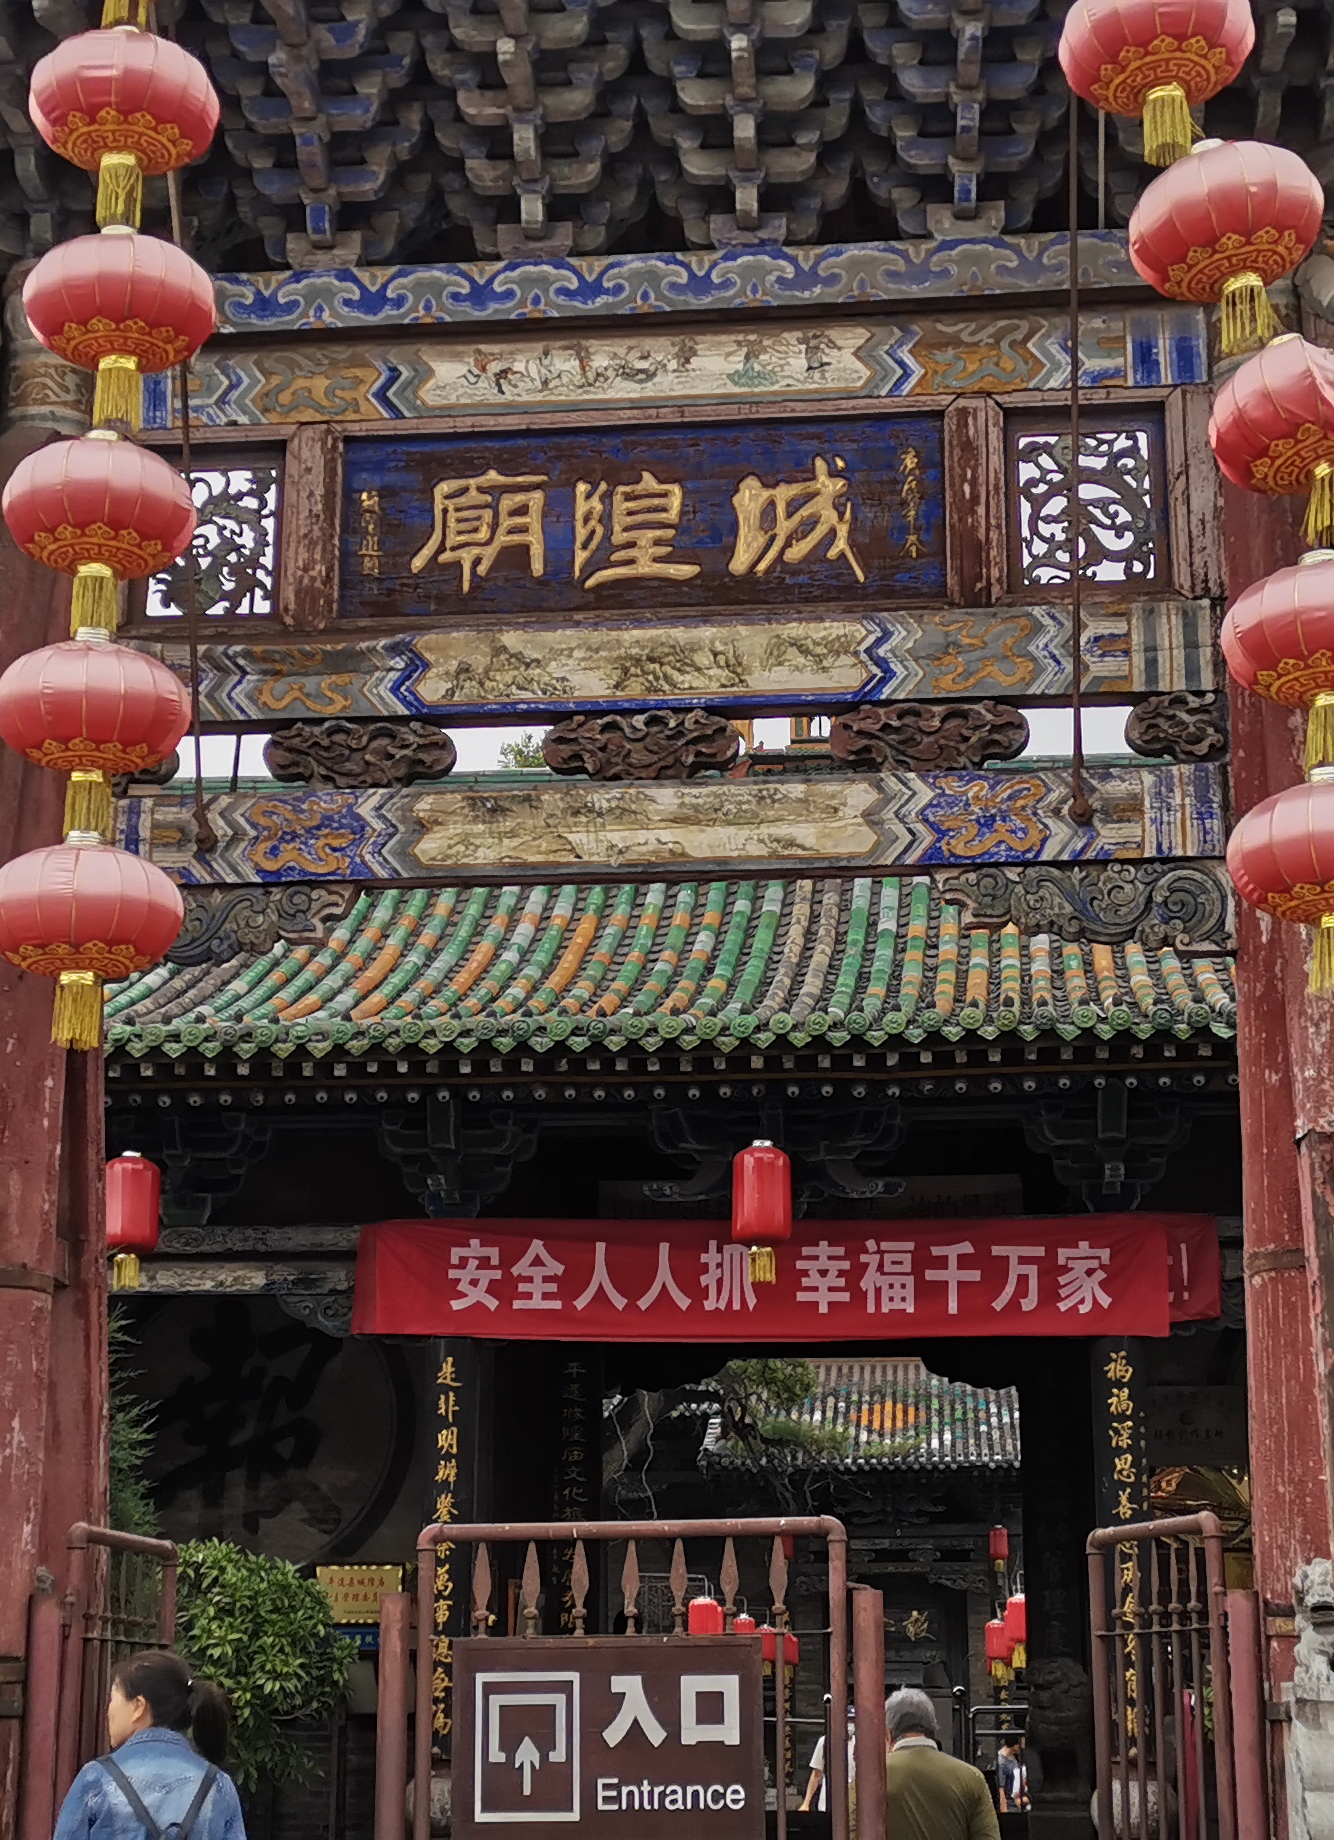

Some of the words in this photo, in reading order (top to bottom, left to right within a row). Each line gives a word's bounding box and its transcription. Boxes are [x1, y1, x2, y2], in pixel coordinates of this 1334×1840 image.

[446, 1237, 757, 1313] 安全人人抓
[795, 1237, 1114, 1315] 幸福千万家
[602, 1674, 741, 1748] 入口
[596, 1776, 747, 1812] Entrance
